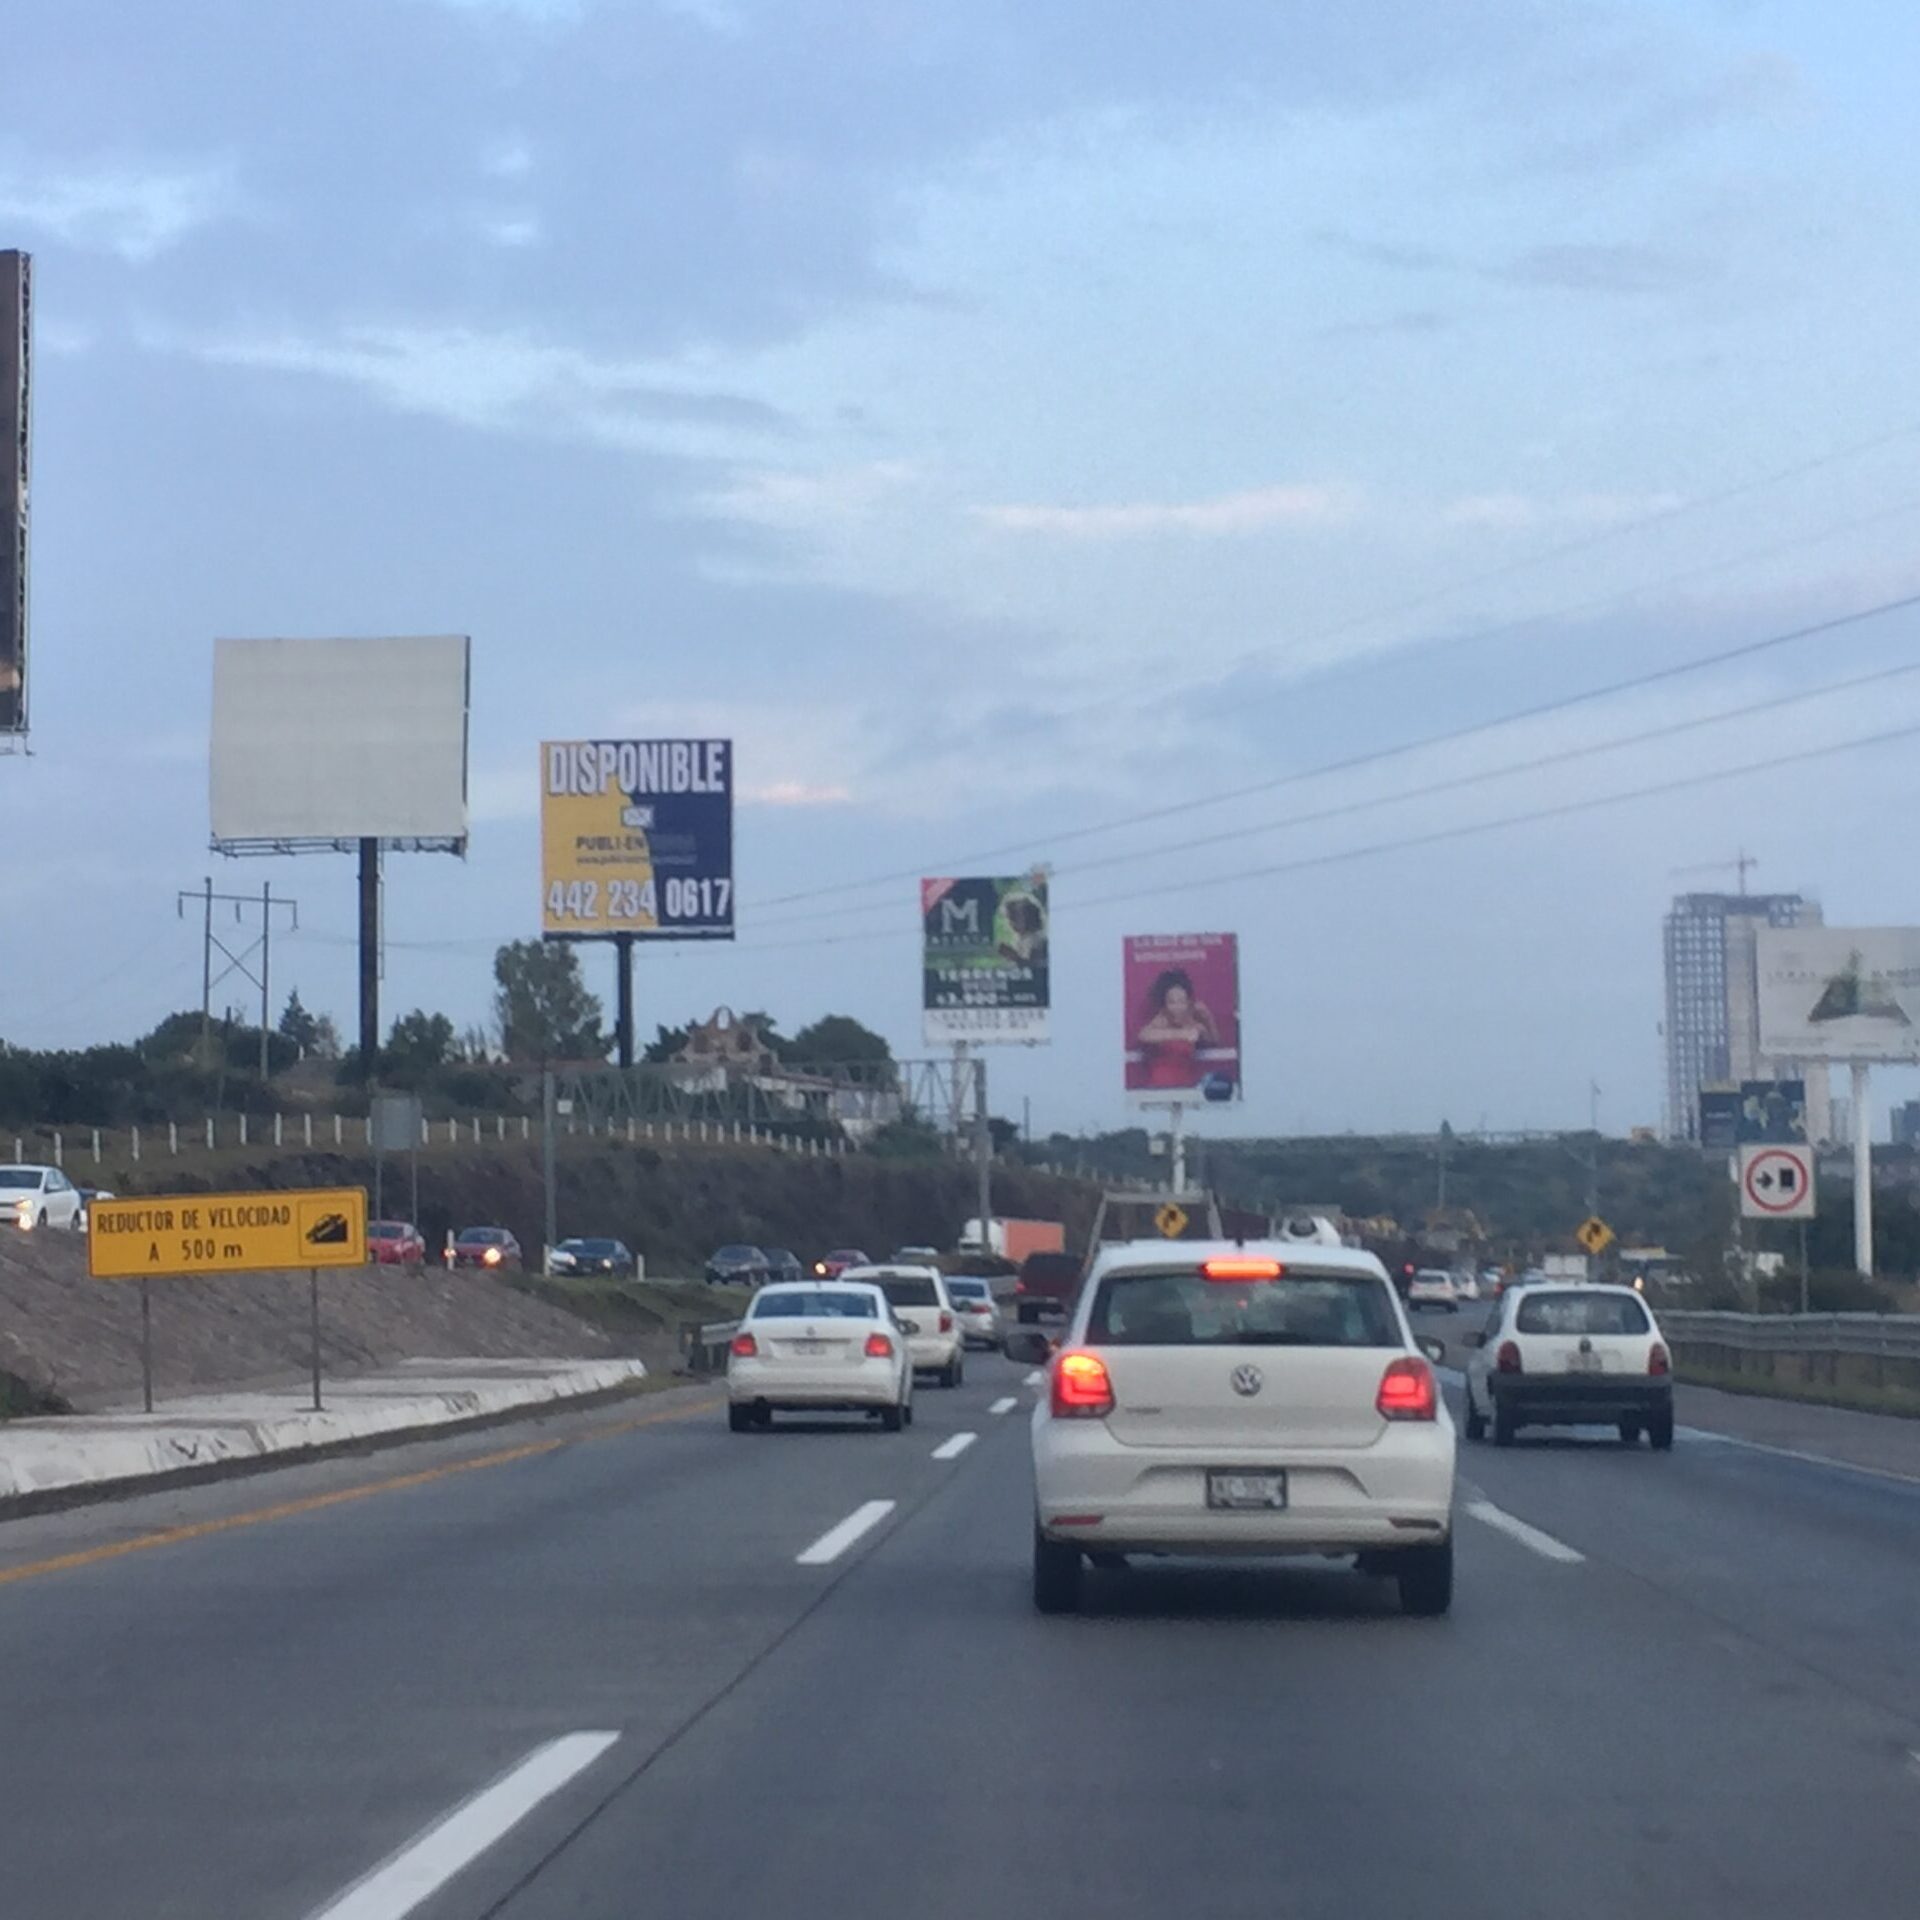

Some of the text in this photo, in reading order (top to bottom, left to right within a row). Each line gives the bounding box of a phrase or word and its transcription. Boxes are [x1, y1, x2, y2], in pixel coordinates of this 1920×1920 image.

[548, 741, 724, 795] DISPONIBLE
[547, 877, 730, 918] 442 234 0617
[941, 898, 980, 933] M
[97, 1205, 291, 1234] REDUCTOR DE VELOCIDAD
[149, 1239, 243, 1262] A 500 m
